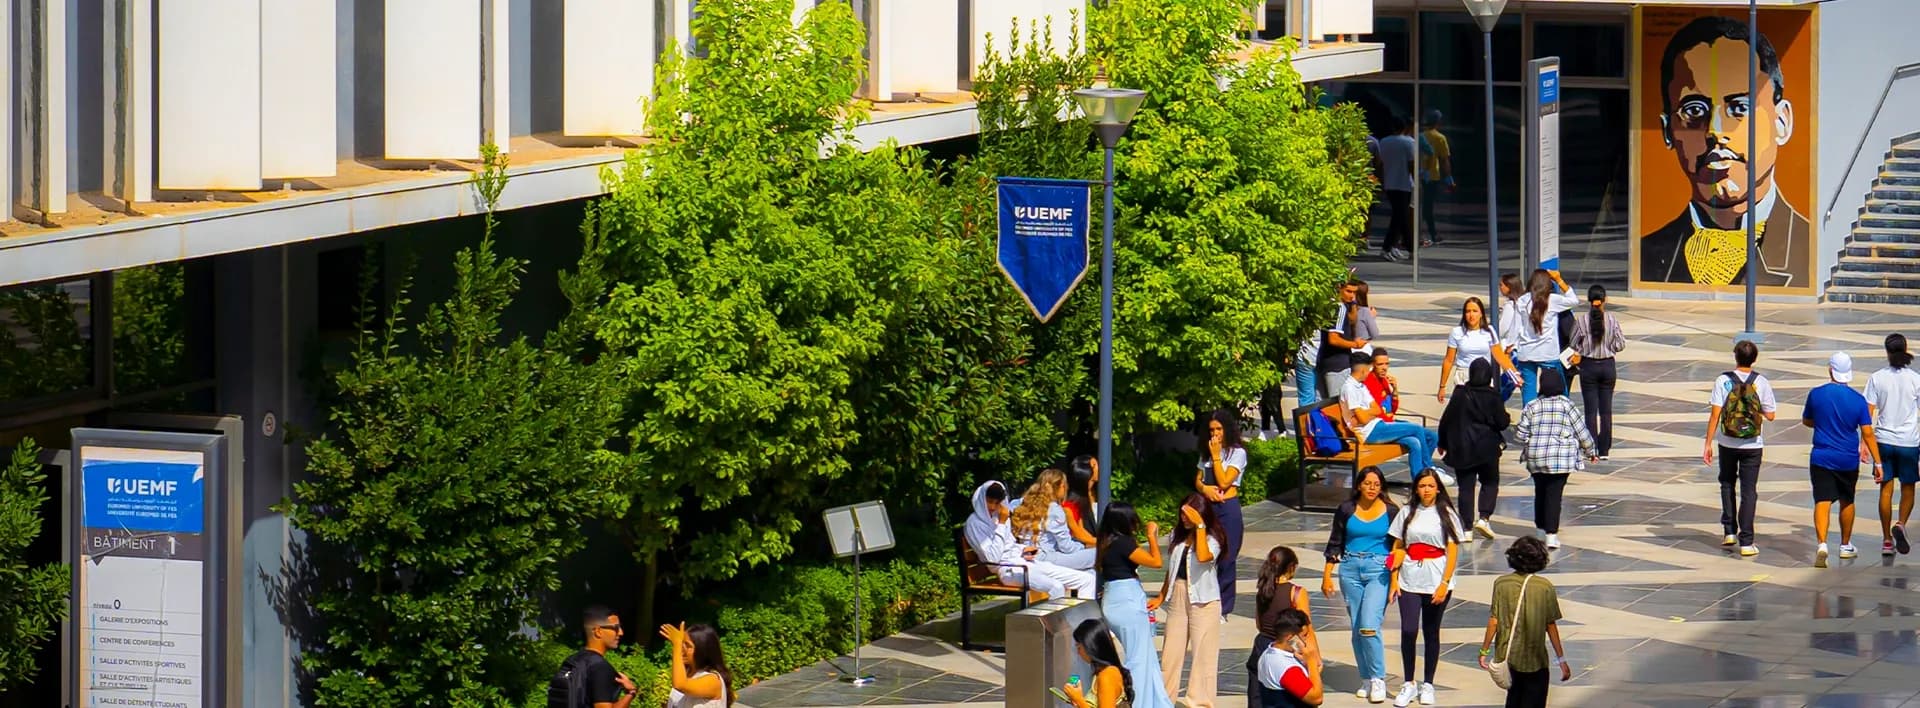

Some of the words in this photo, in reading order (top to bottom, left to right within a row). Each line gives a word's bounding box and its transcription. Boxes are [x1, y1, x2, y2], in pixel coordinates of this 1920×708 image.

[1027, 206, 1073, 220] UEMF
[123, 479, 178, 497] UEMF
[94, 535, 157, 550] BÂTIMENT
[167, 535, 176, 555] 1
[99, 636, 122, 645] CENTRE
[99, 657, 117, 665] SALLE
[99, 673, 117, 681] SALLE
[99, 697, 117, 705] SALLE
